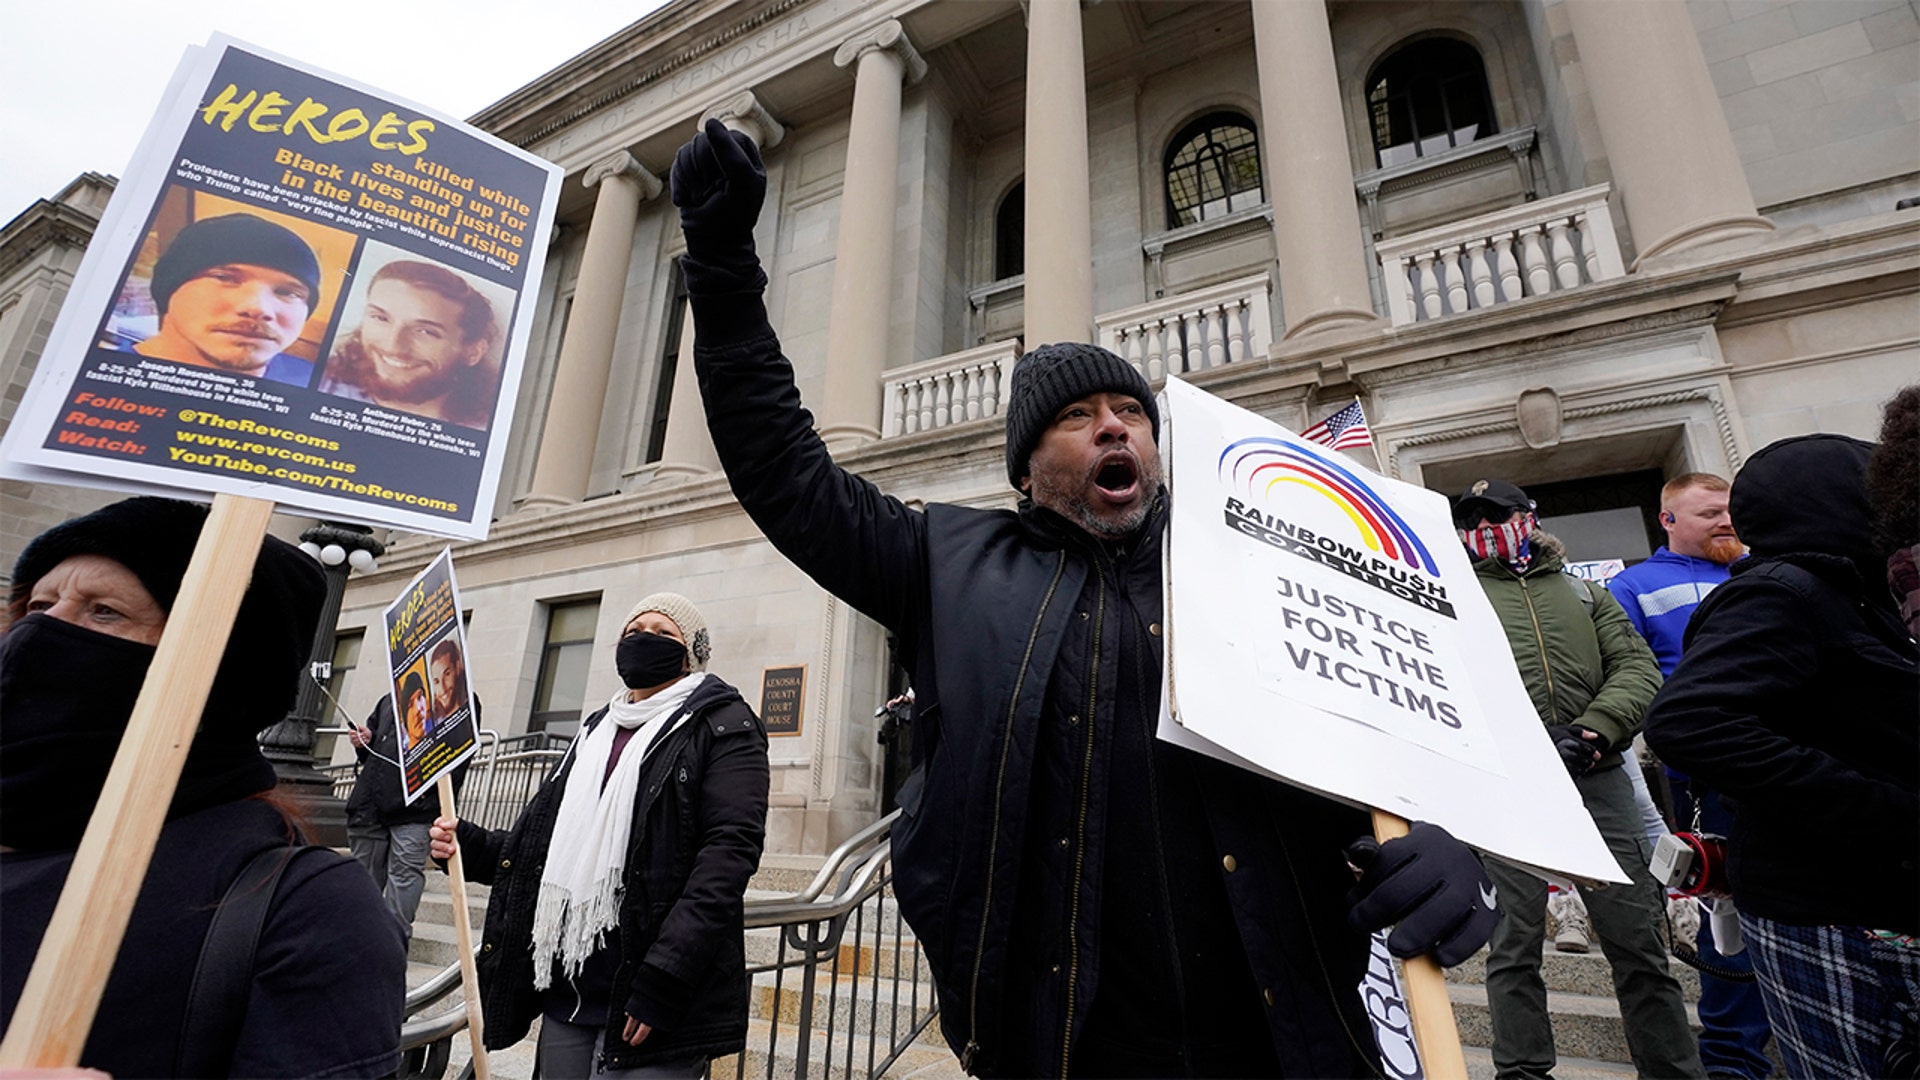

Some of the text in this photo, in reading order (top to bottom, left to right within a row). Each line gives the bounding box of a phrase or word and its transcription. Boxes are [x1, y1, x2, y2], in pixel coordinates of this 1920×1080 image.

[600, 17, 811, 133] OF KENOSHA
[200, 83, 435, 155] HEROES
[176, 168, 201, 182] who
[205, 175, 241, 193] Trump
[243, 188, 279, 203] called
[313, 207, 334, 219] fine
[180, 158, 514, 274] Protesters have been attacked by fascist white supremacist thugs.
[274, 148, 523, 247] Black lives and justice
[281, 169, 520, 267] in the beautiful rising
[370, 162, 527, 231] standing up for
[414, 157, 530, 217] killed while
[85, 370, 123, 384] fascist
[124, 376, 148, 389] Kyle
[150, 381, 212, 400] Rittenhouse
[214, 391, 225, 401] in
[275, 404, 290, 414] WI
[137, 360, 175, 375] Joseph
[147, 372, 198, 387] Murdered
[199, 380, 213, 392] by
[214, 383, 231, 394] the
[233, 386, 260, 399] white
[262, 391, 285, 403] teen
[65, 411, 357, 473] Read: www.revcom.us
[74, 392, 340, 451] Follow: @TheRevcoms
[309, 412, 342, 427] fascist
[342, 419, 362, 432] Kyle
[364, 425, 416, 443] Rittenhouse
[418, 437, 428, 446] in
[469, 449, 481, 458] WI
[361, 415, 405, 431] Murdered
[405, 425, 416, 436] by
[417, 429, 432, 438] the
[433, 432, 456, 444] white
[457, 438, 476, 448] teen
[362, 407, 399, 423] Anthony
[58, 430, 458, 513] Watch: YouTube.com/TheRevcoms
[1226, 497, 1362, 563] RAINBOW
[1237, 518, 1440, 611] COALITION
[1277, 576, 1434, 654] JUSTICE
[1282, 606, 1448, 690] FOR THE
[766, 677, 801, 687] KENOSHA
[767, 689, 796, 699] COUNTY
[1284, 640, 1462, 729] VICTIMS
